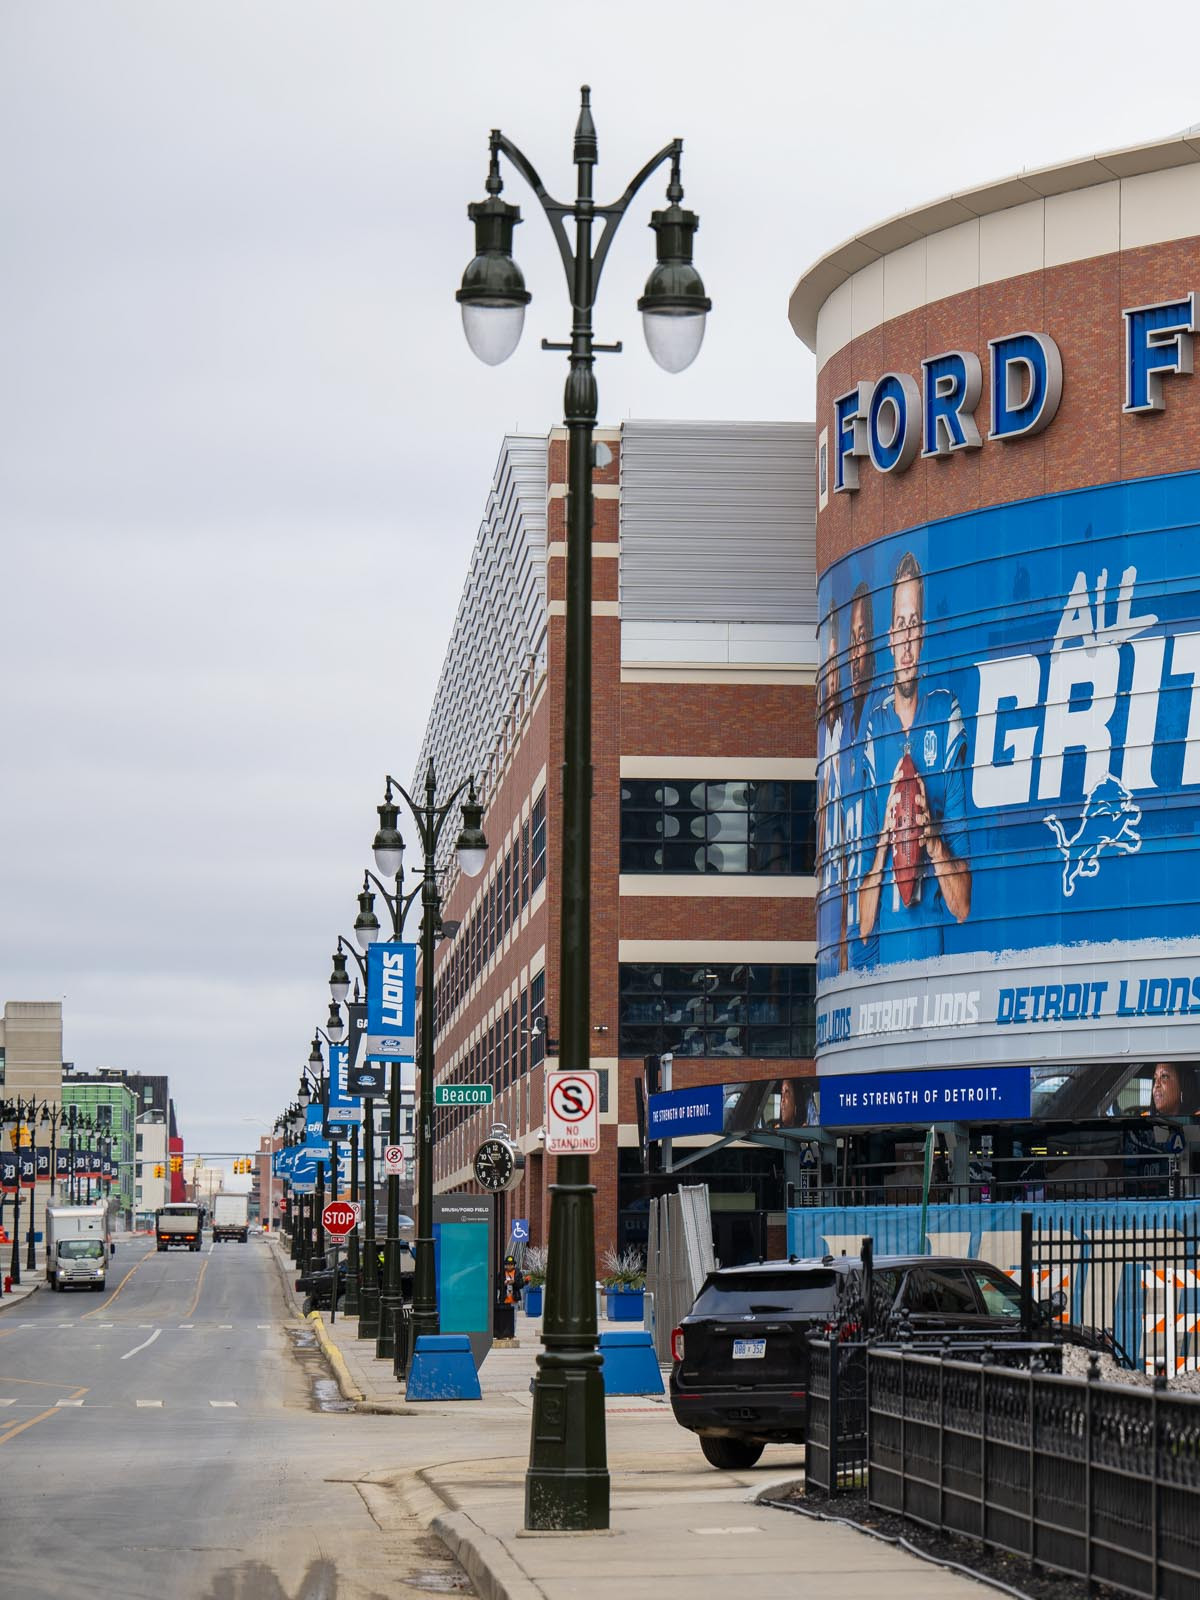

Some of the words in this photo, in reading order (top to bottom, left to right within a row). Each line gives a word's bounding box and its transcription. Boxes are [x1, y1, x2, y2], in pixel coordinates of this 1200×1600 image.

[833, 331, 1063, 494] FORD
[1050, 566, 1158, 663] ALL
[382, 952, 403, 1026] LIONS
[996, 981, 1108, 1025] DETROIT
[856, 996, 918, 1038] DETROIT
[920, 991, 980, 1029] LIONS
[442, 1088, 487, 1102] Beacon
[839, 1094, 857, 1107] THE
[863, 1090, 918, 1105] STRENGTH
[924, 1089, 938, 1103] OF
[944, 1087, 1002, 1102] DETROIT.
[659, 1108, 678, 1122] STRENGTH
[679, 1106, 685, 1119] OF
[686, 1104, 711, 1118] DETROIT.
[566, 1126, 579, 1136] NO
[551, 1138, 595, 1149] STANDING
[325, 1212, 353, 1224] STOP
